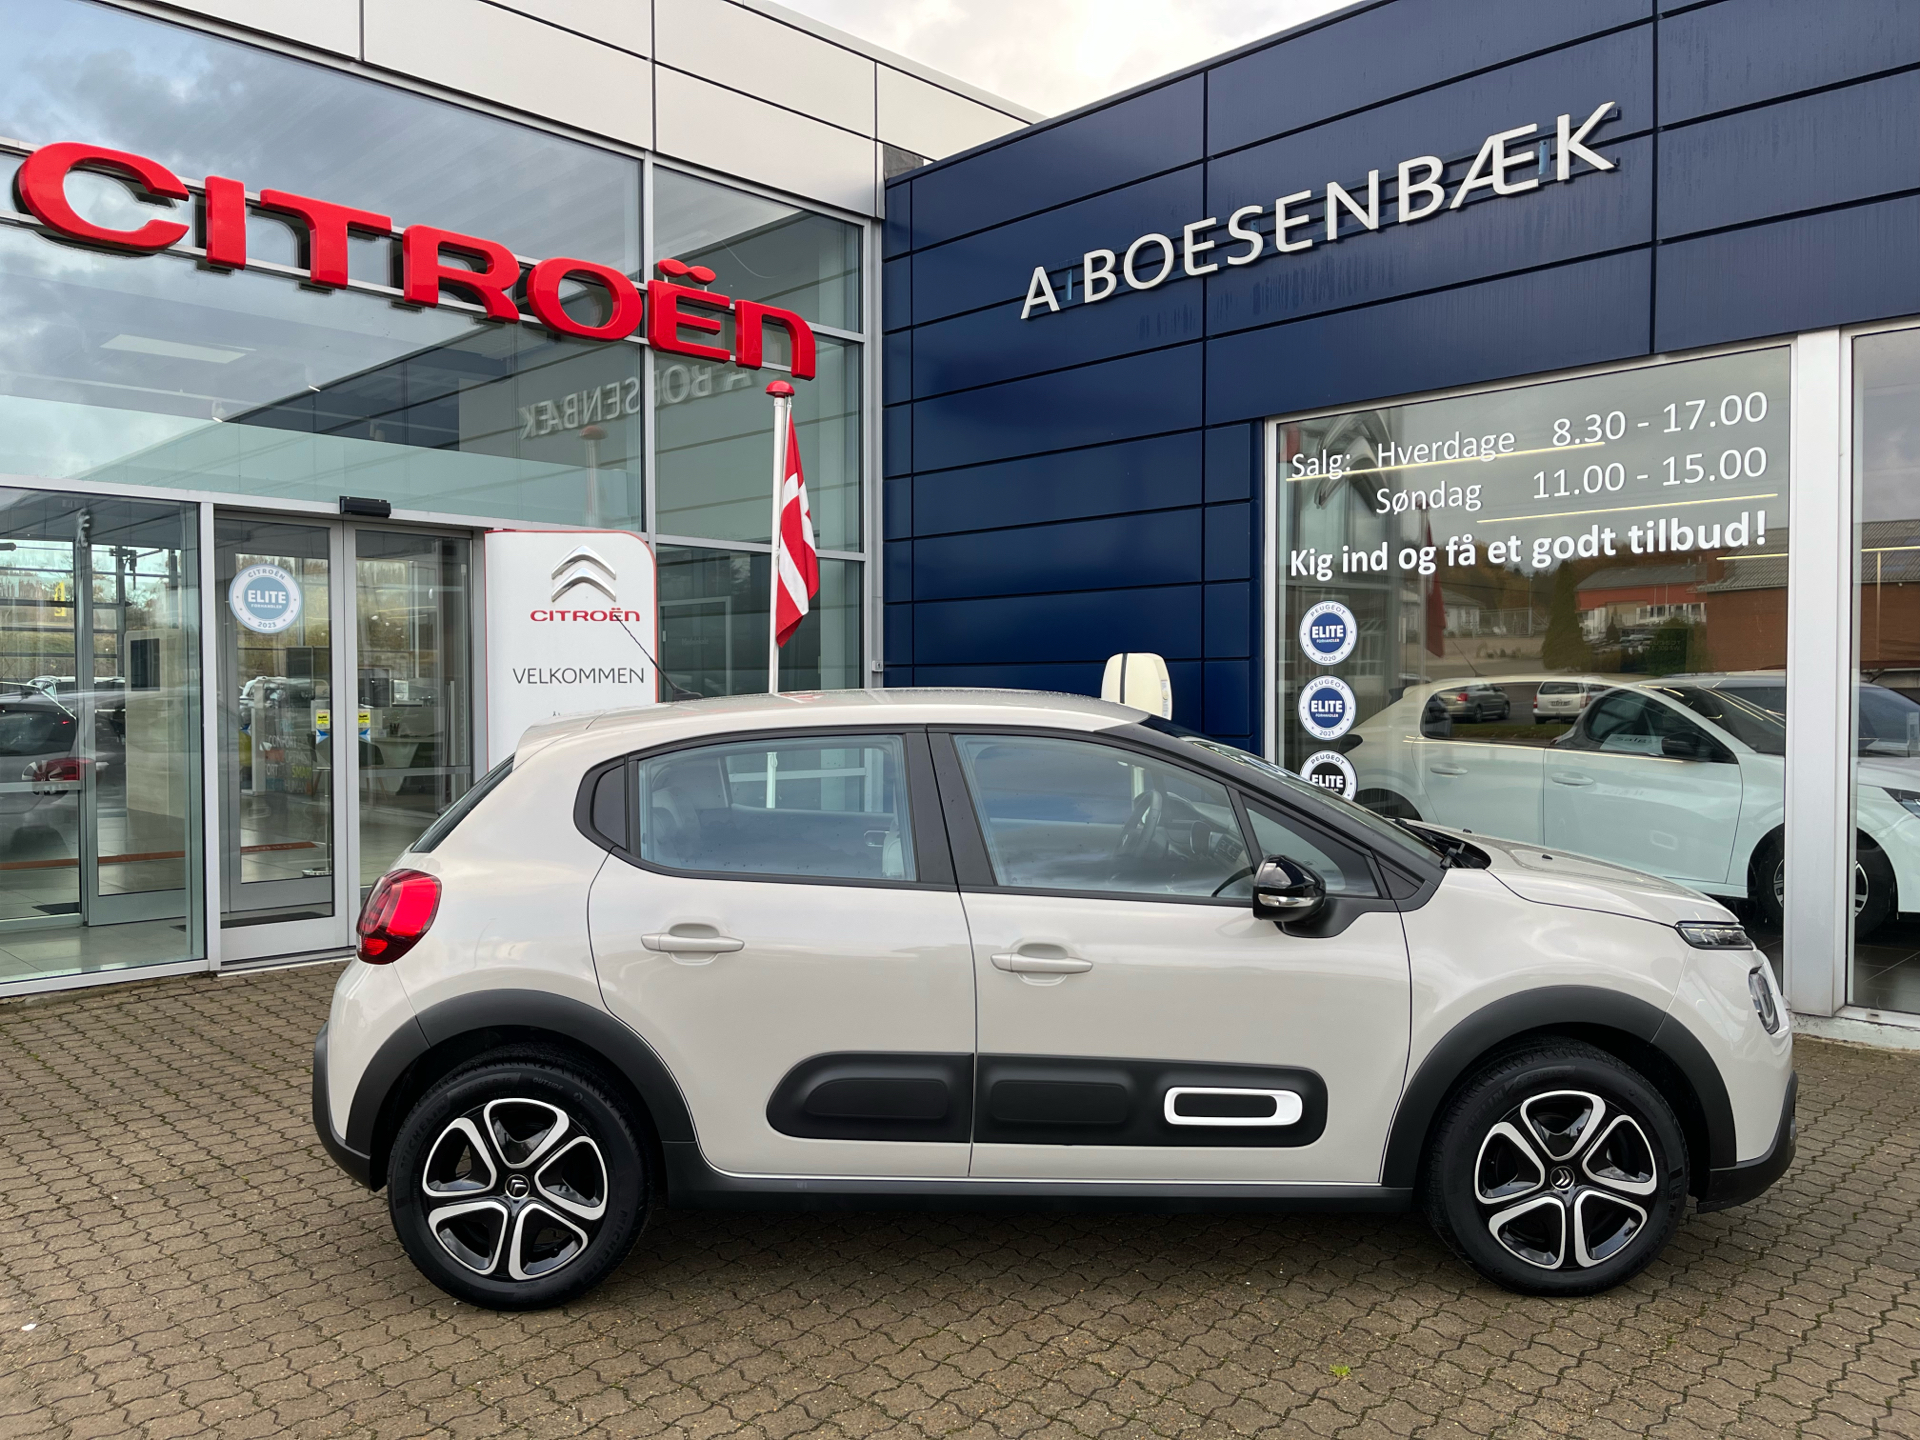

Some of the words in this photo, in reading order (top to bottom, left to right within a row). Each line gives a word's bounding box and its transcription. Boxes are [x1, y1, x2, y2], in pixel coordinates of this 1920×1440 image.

[1020, 265, 1060, 320] A
[1083, 101, 1618, 304] BOESENBÆK
[1290, 449, 1352, 481] Salg:
[1376, 430, 1517, 468] Hverdage
[1552, 410, 1627, 447] 8.30
[1662, 390, 1769, 434] 17.00
[1375, 482, 1483, 515] Søndag
[1532, 462, 1626, 500] 11.00
[1661, 446, 1767, 488] 15.00
[1290, 547, 1333, 581] Kig
[1341, 541, 1389, 574] ind
[1398, 546, 1437, 576] og
[1445, 535, 1477, 568] få
[1487, 533, 1522, 564] et
[1532, 525, 1617, 569] godt
[1627, 510, 1767, 556] tilbud!
[248, 567, 286, 581] CITROËN
[247, 589, 287, 604] ELITE
[1310, 603, 1347, 618] PEUGEOT
[257, 621, 277, 629] 2023
[1311, 624, 1344, 639] ELITE
[512, 667, 645, 684] VELKOMMEN
[1309, 679, 1345, 692] PEUGEOT
[1310, 699, 1343, 713] ELITE
[1319, 729, 1335, 737] 2021
[1310, 753, 1345, 766] PEUGEOT
[1311, 774, 1344, 788] ELITE
